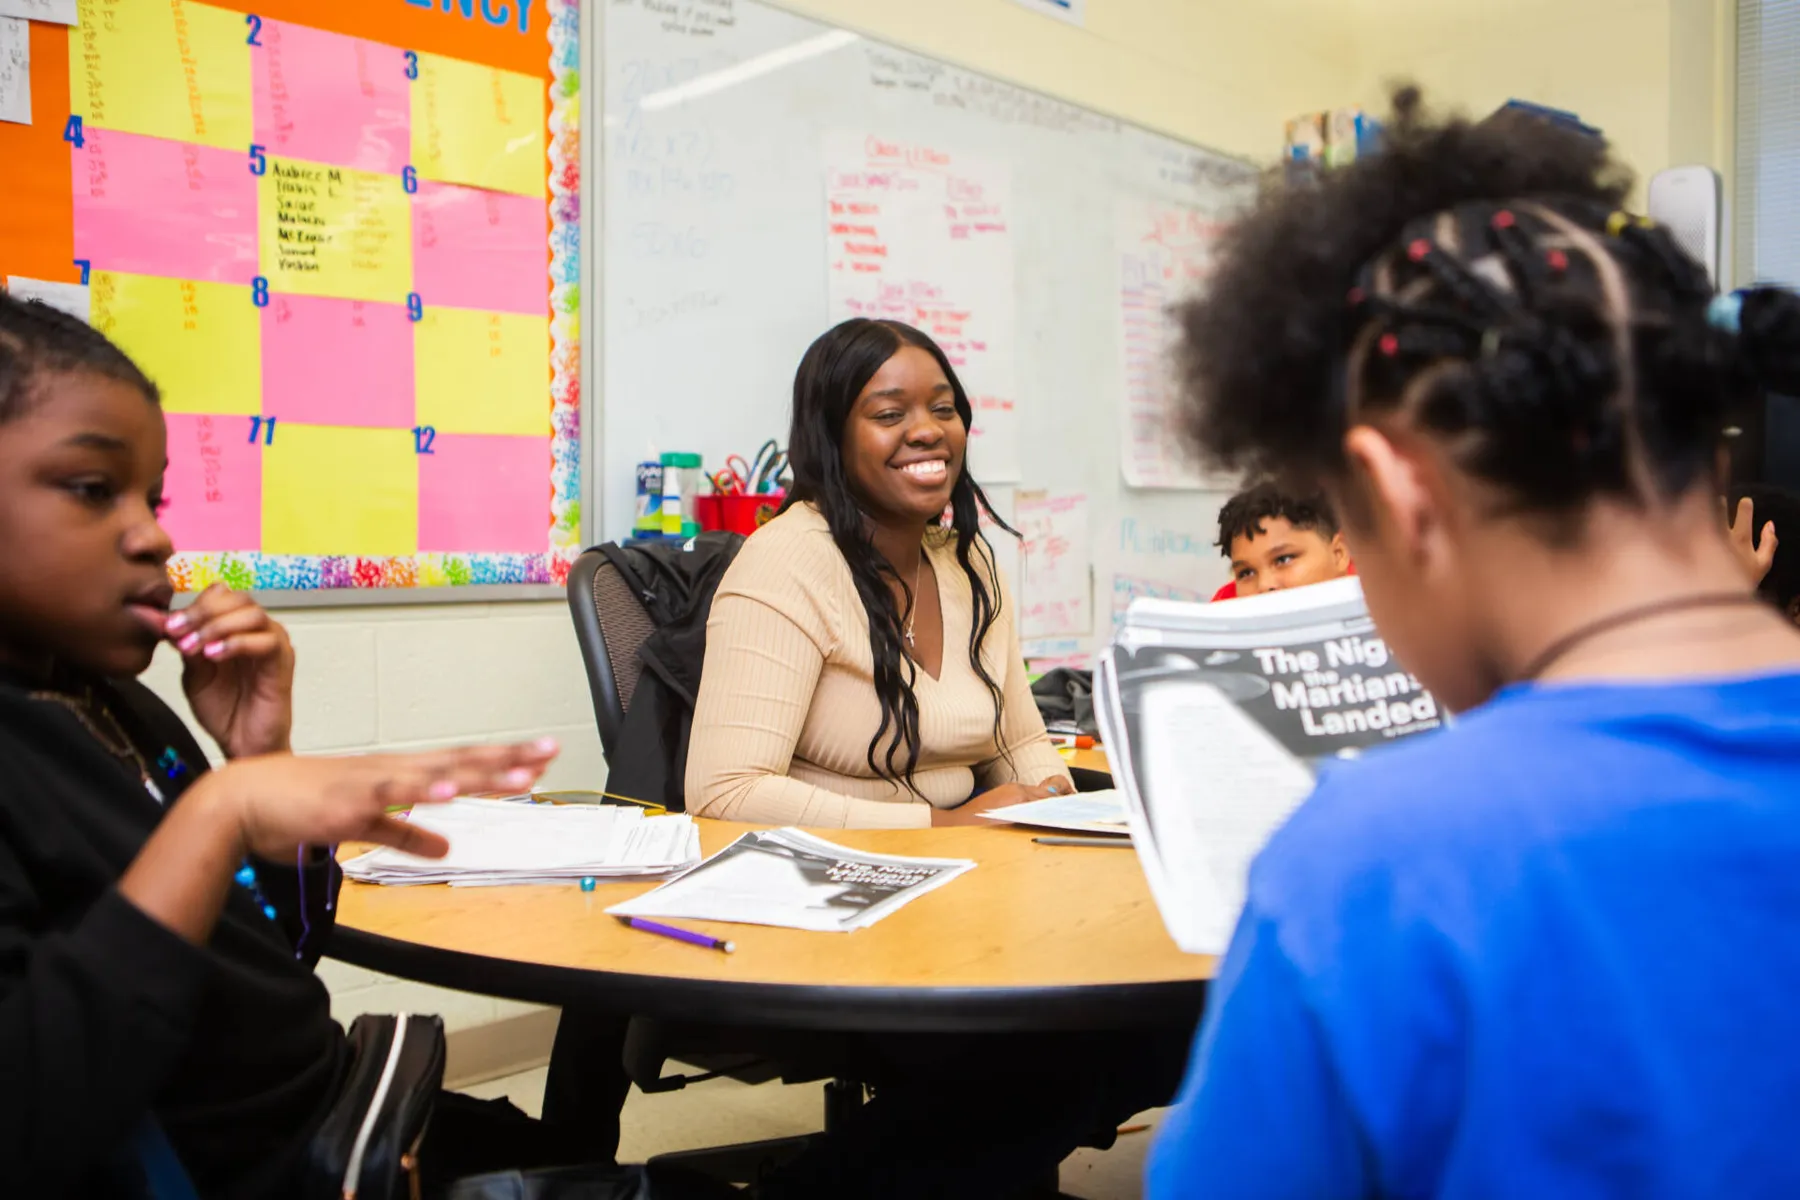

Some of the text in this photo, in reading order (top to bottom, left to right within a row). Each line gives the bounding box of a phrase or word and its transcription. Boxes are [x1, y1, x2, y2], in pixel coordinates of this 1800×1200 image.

[246, 14, 262, 46] 2
[405, 0, 532, 33] CY
[404, 51, 418, 80] 3
[63, 115, 85, 148] 4
[249, 144, 267, 176] 5
[402, 165, 418, 194] 6
[73, 259, 91, 285] 7
[252, 276, 269, 308] 8
[407, 293, 423, 322] 9
[248, 415, 277, 446] 11
[412, 425, 436, 455] 12
[1253, 636, 1394, 675] The Nig
[1303, 669, 1340, 688] the
[1300, 689, 1437, 737] Landed
